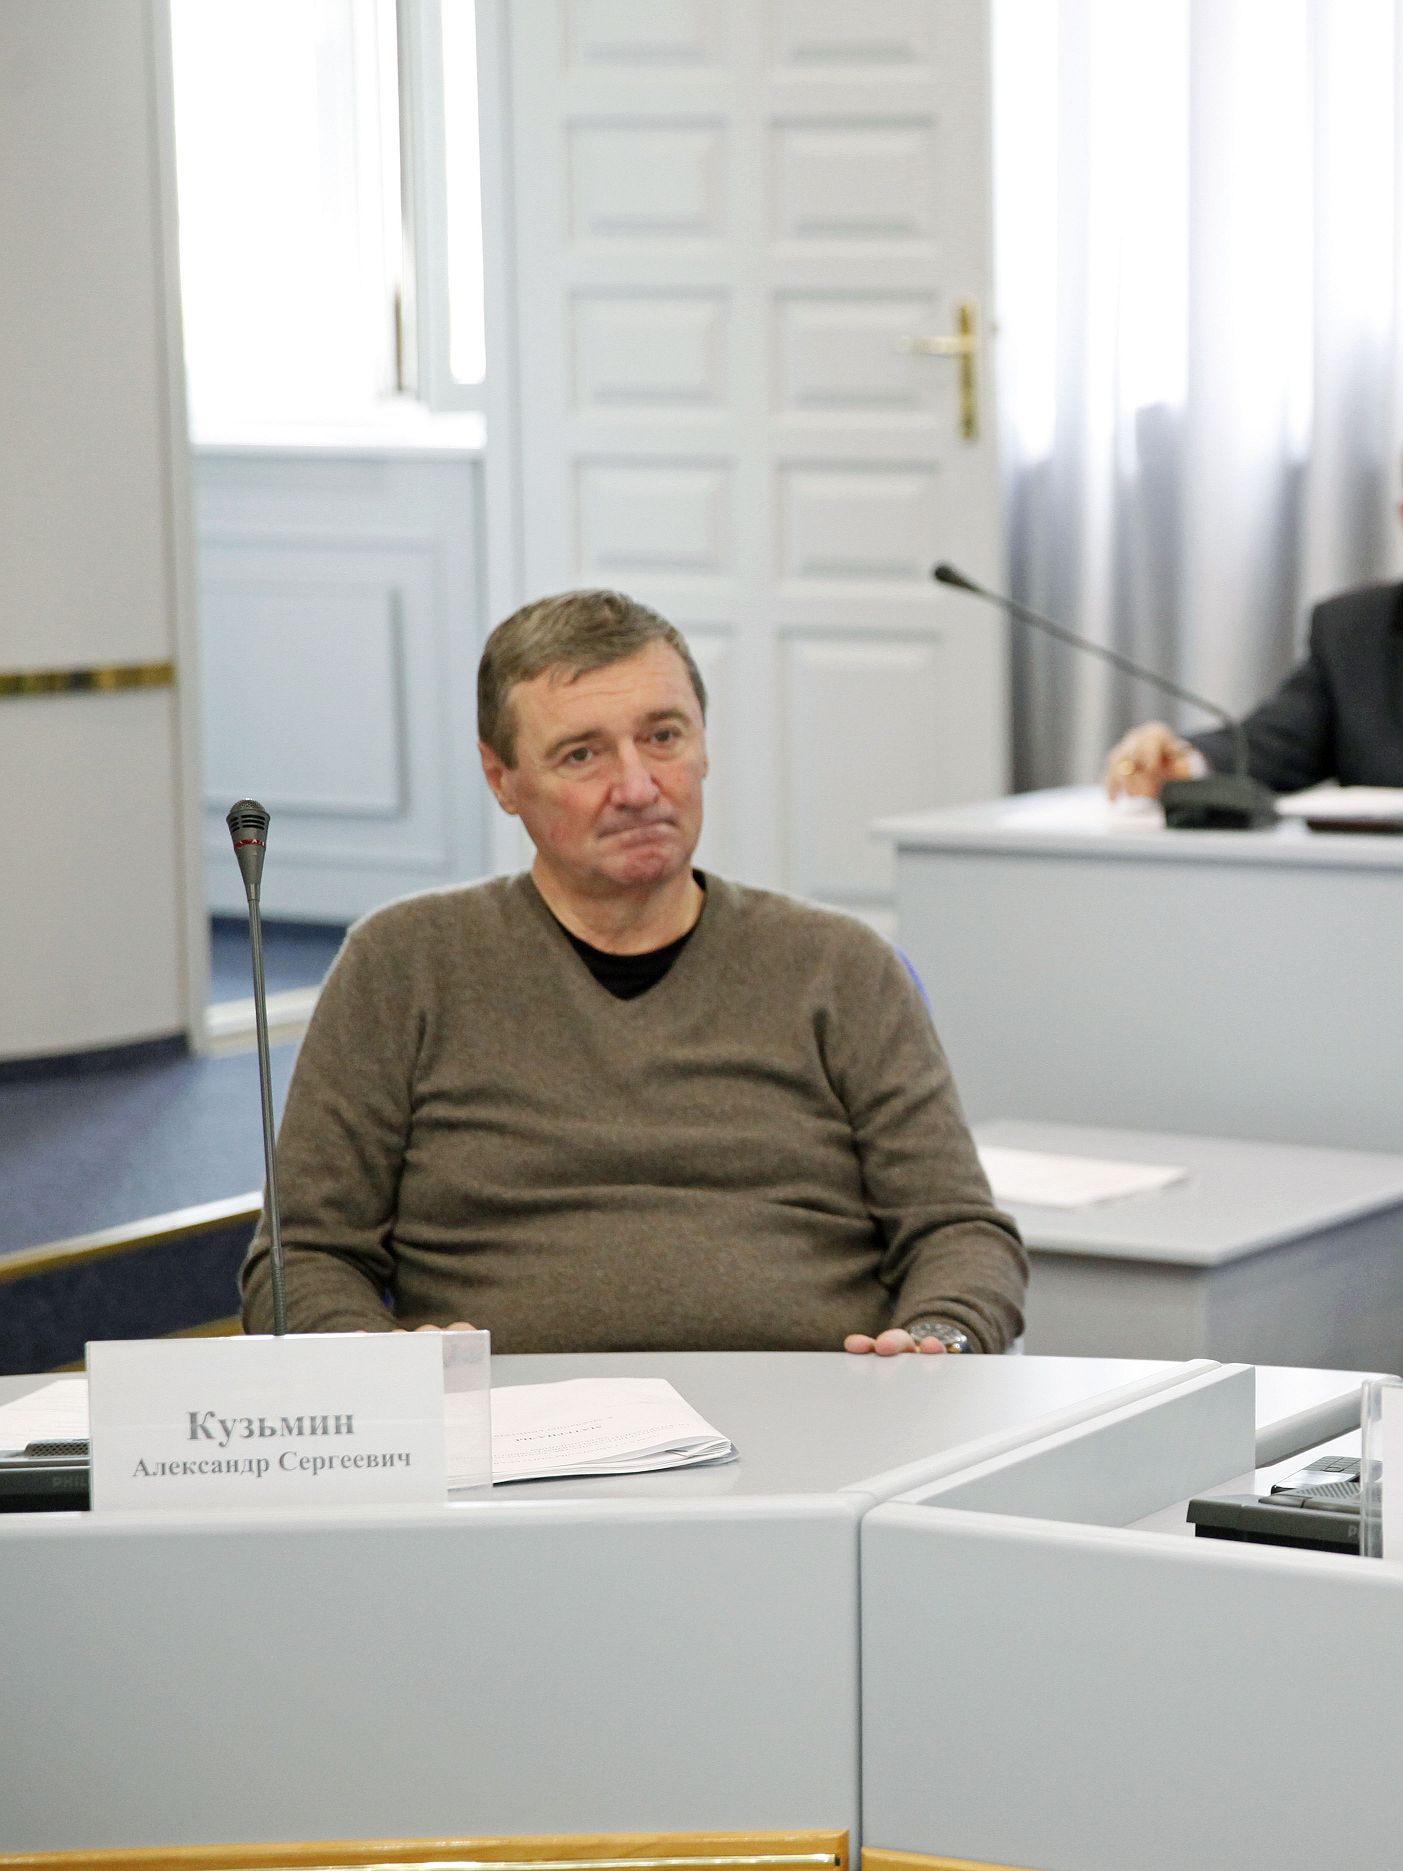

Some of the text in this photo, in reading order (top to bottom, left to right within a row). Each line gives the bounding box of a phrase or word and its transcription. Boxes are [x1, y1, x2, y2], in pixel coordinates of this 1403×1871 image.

[187, 1410, 355, 1447] Кузьмин
[132, 1450, 412, 1479] Александр Сергеевич
